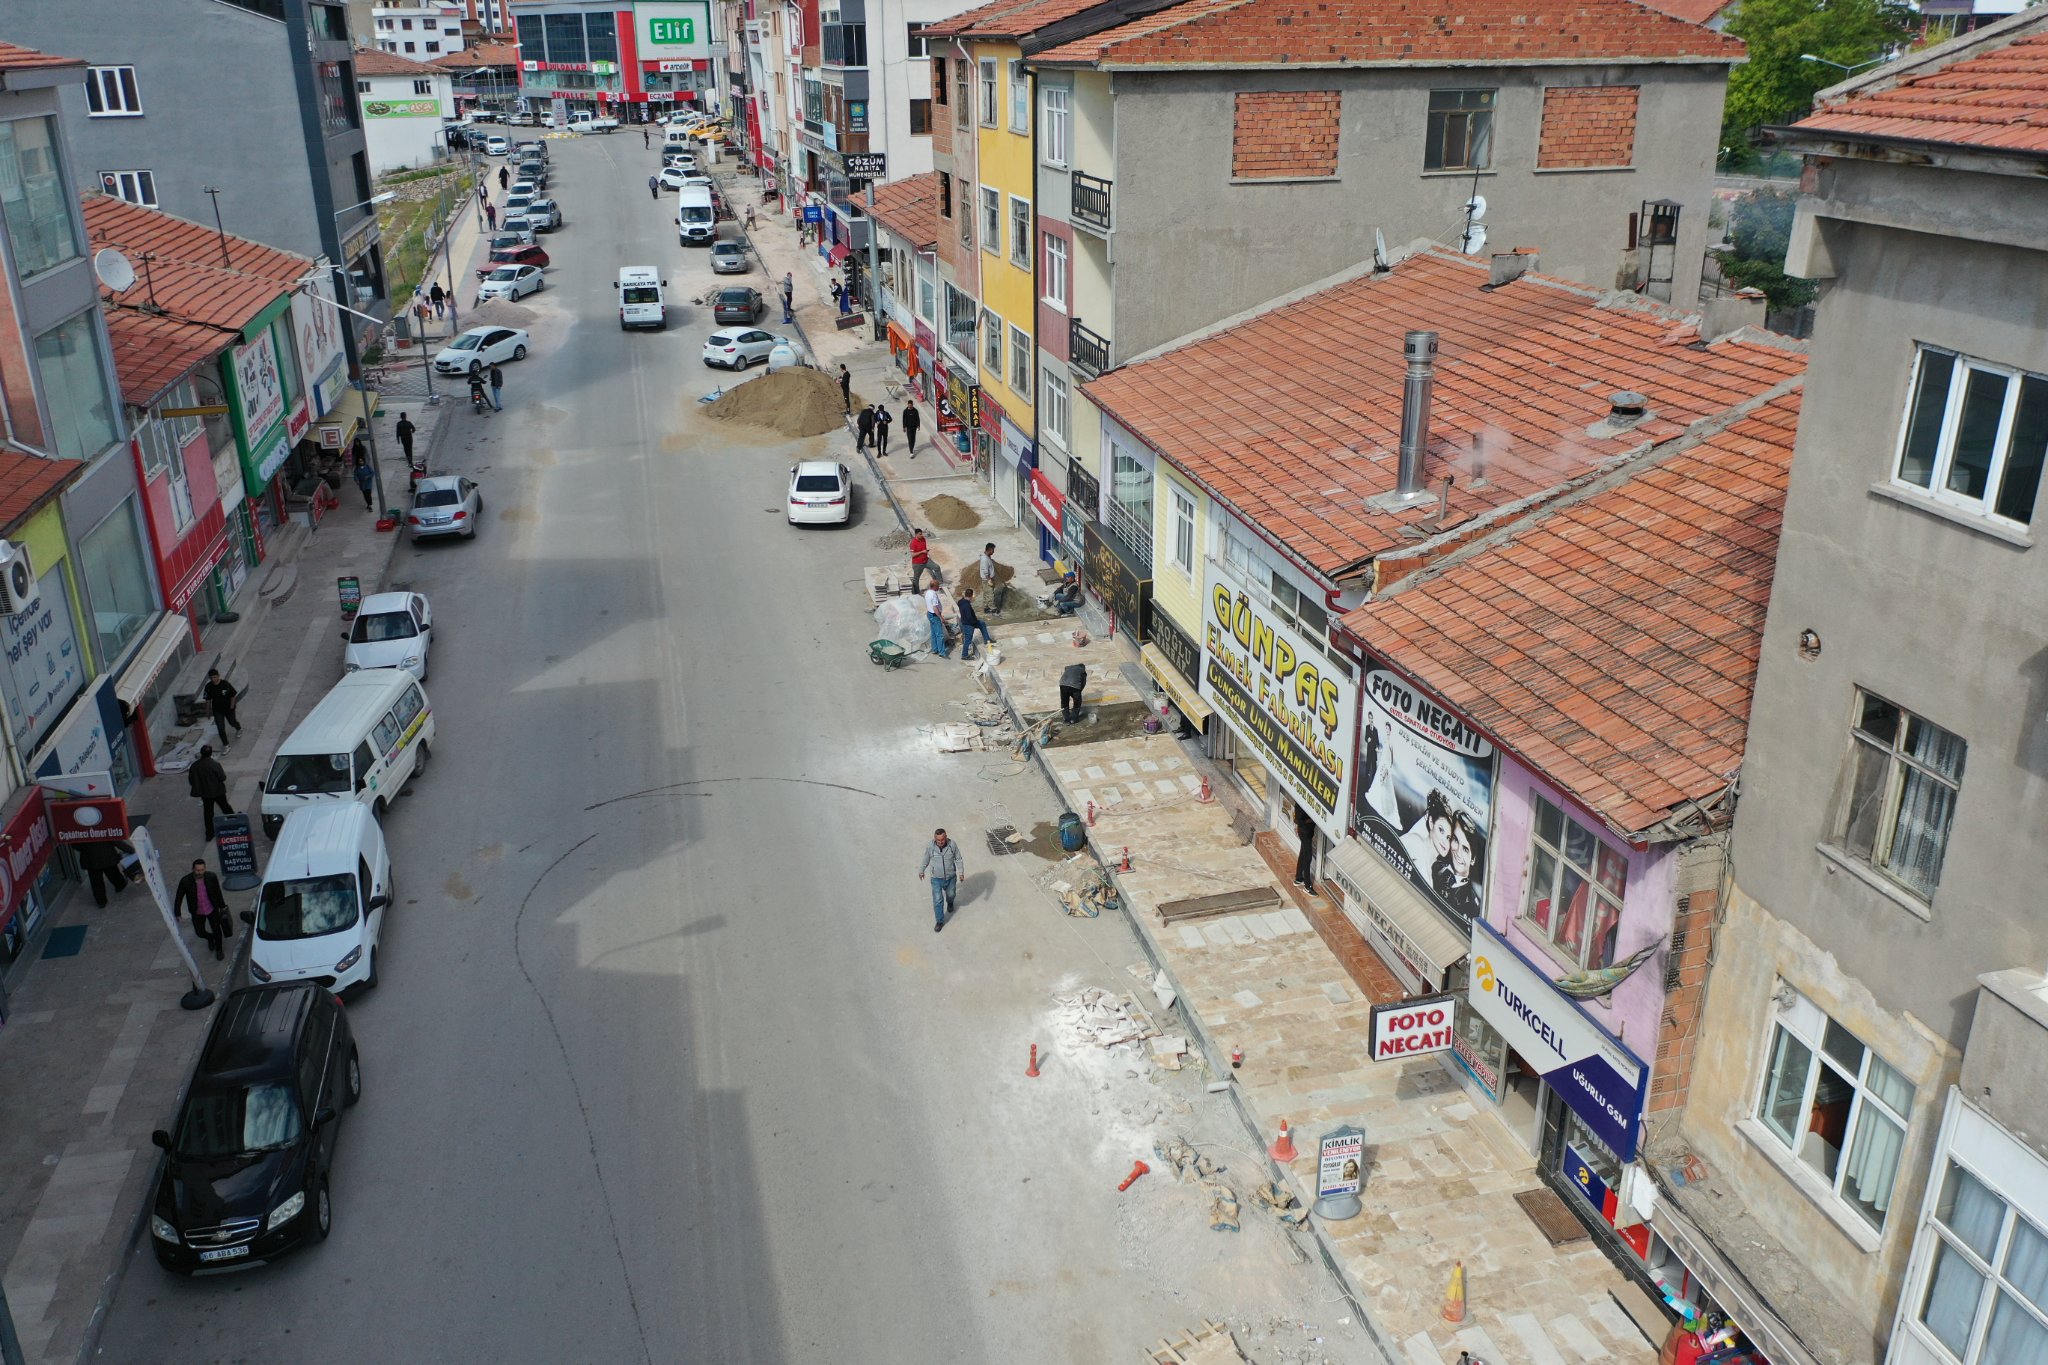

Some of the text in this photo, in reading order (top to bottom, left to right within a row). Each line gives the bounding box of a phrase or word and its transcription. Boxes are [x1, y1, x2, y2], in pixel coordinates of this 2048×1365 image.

[654, 21, 691, 40] Elif
[848, 155, 884, 167] ÇÖZÜM
[325, 431, 338, 445] E
[22, 624, 38, 656] şey
[38, 608, 52, 633] var
[1152, 609, 1192, 665] EROĞLU
[1156, 632, 1187, 673] SARRAF
[1213, 583, 1339, 740] GÜNPAŞ
[1373, 674, 1412, 713] FOTO
[107, 828, 123, 837] Usta
[1336, 871, 1405, 950] FOTO NECATİ
[1388, 1009, 1445, 1033] FOTO
[1496, 978, 1567, 1061] TURKCELL
[1379, 1026, 1452, 1056] NECATİ
[1572, 1067, 1628, 1130] UĞURLU GSM
[1325, 1137, 1360, 1149] KİMLİK
